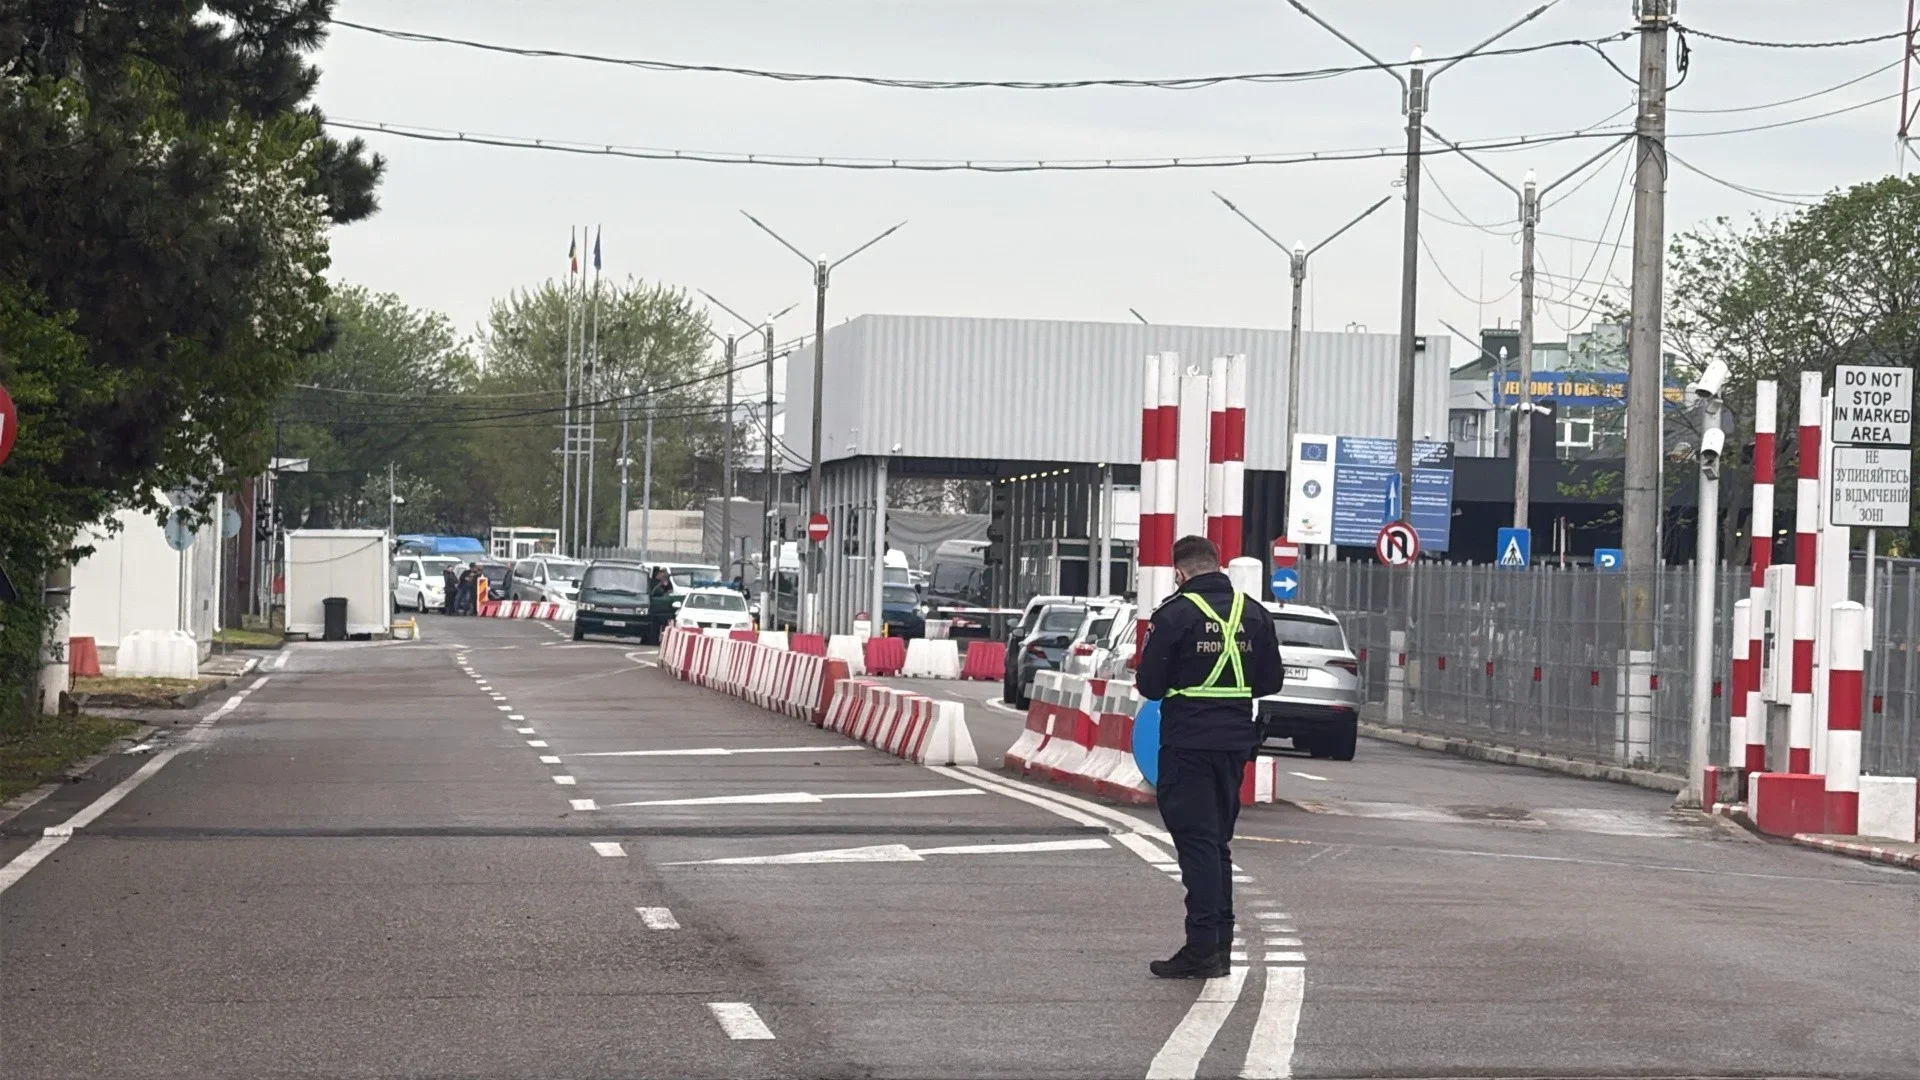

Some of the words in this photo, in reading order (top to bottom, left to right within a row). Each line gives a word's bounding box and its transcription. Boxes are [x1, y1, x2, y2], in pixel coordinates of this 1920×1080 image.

[1845, 371, 1866, 386] DO
[1871, 372, 1902, 388] NOT
[1557, 382, 1573, 396] TO
[1853, 391, 1892, 406] STOP
[1834, 407, 1848, 421] IN
[1852, 408, 1910, 424] MARKED
[1851, 427, 1892, 442] AREA
[1865, 450, 1880, 464] НЕ
[1835, 467, 1909, 484] ЗУПИНЯЙТЕСЬ
[1835, 488, 1842, 502] В
[1845, 487, 1909, 503] ВІДМІЧЕНІЙ
[1859, 508, 1884, 522] ЗОНІ
